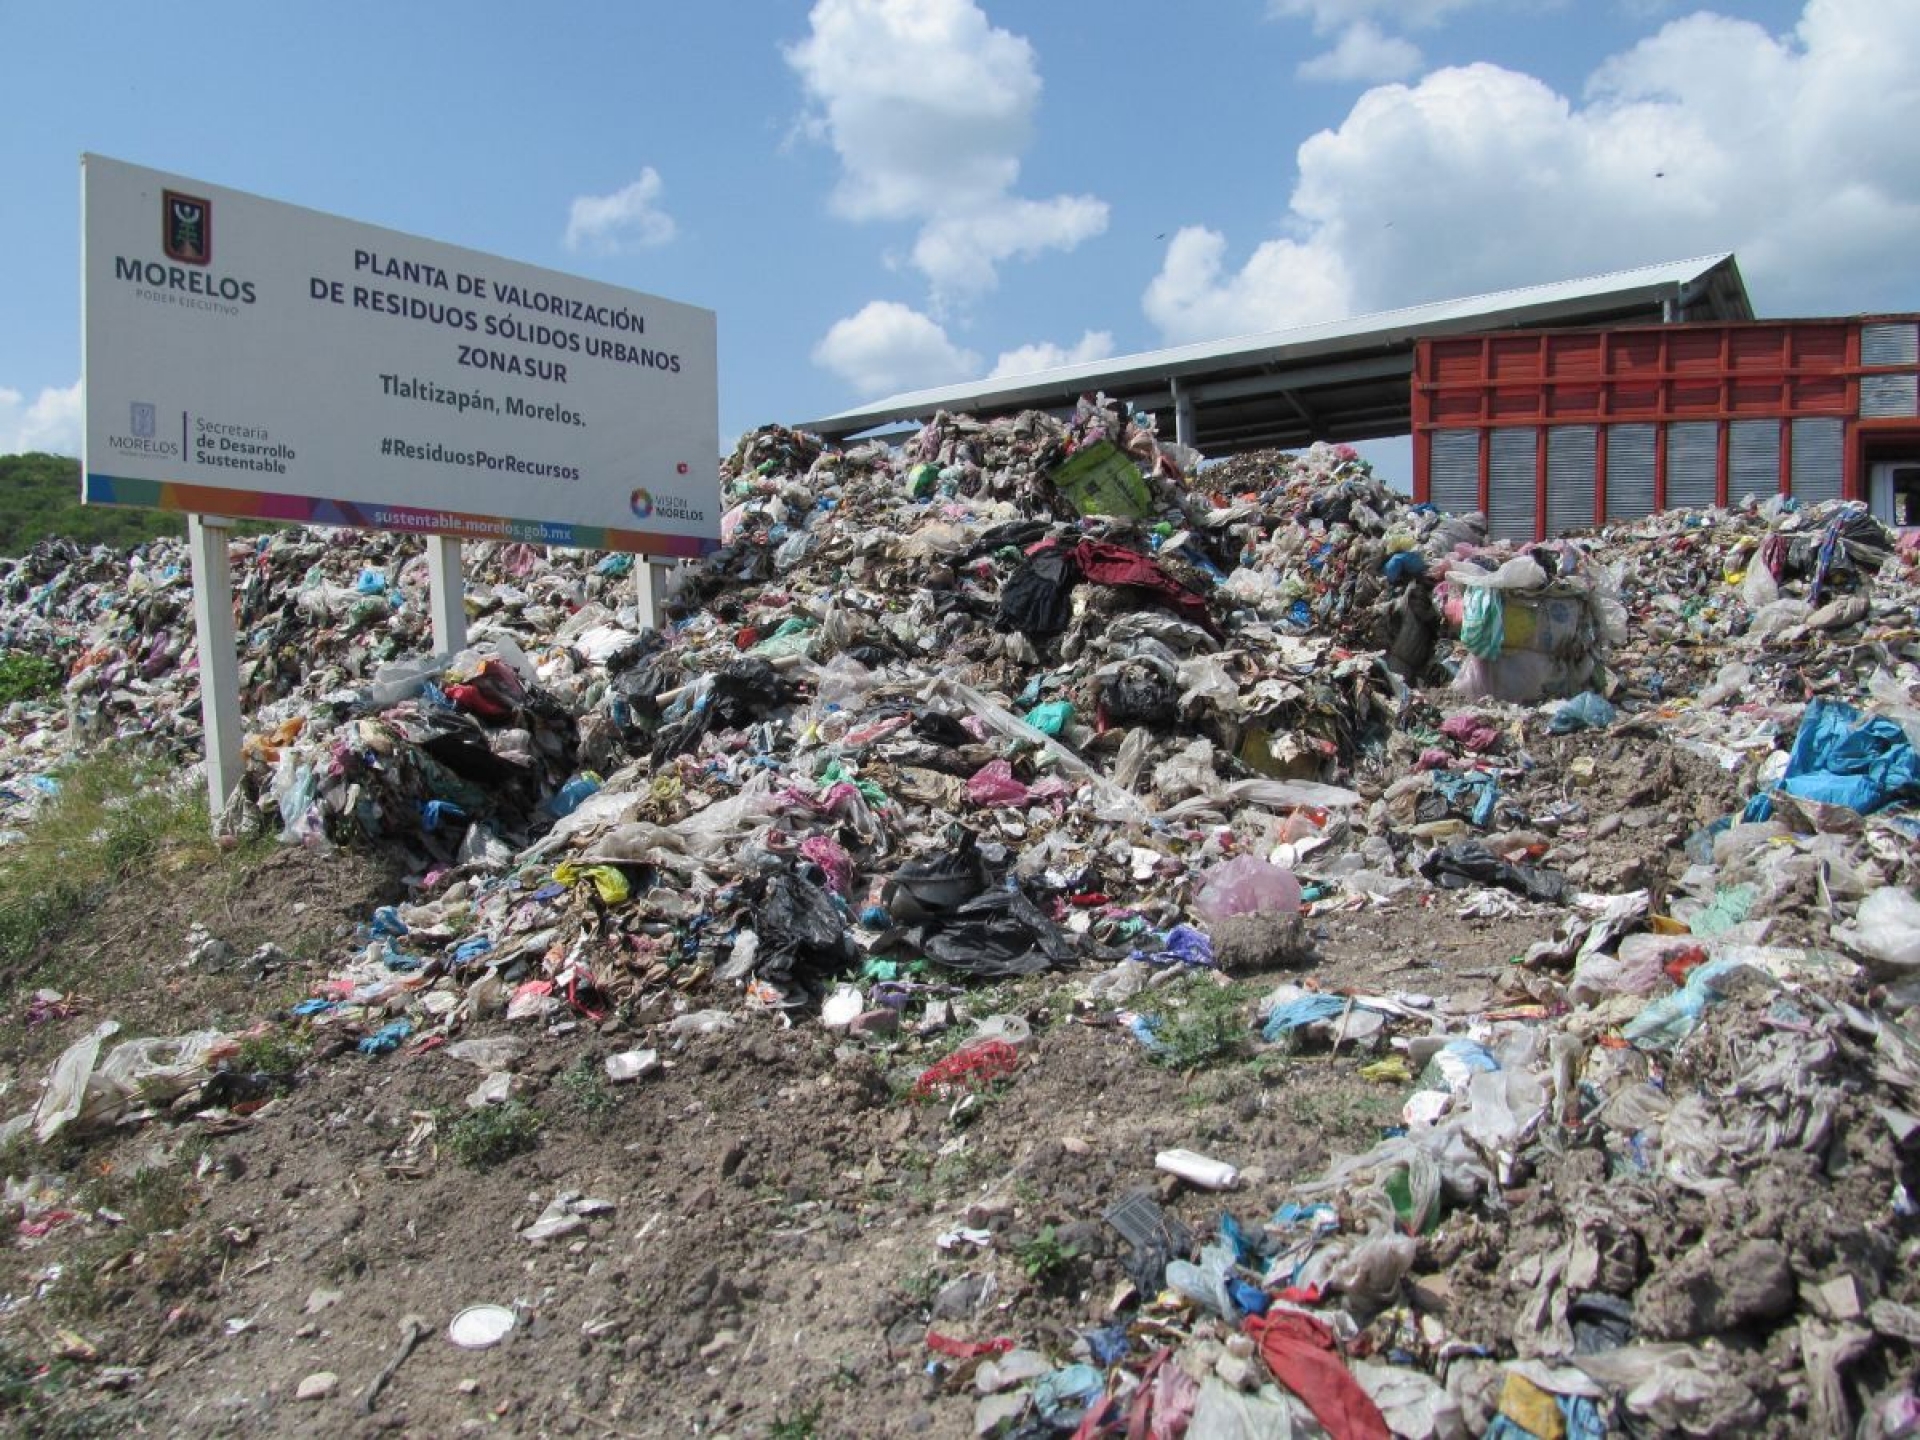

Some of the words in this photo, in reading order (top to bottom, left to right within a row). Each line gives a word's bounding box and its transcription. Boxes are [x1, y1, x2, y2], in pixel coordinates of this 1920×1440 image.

[115, 256, 257, 304] MORELOS
[354, 249, 449, 290] PLANTA
[457, 273, 487, 299] DE
[492, 280, 645, 334] VALORIZACIÓN
[135, 288, 175, 304] PODER
[310, 277, 345, 304] DE
[353, 285, 478, 331] RESIDUOS
[485, 313, 580, 352] SÓLIDOS
[585, 336, 681, 373] URBANOS
[379, 373, 500, 415] Tlaltizapán,
[505, 396, 586, 428] Morelos.
[109, 435, 178, 456] MORELOS
[196, 433, 216, 449] de
[219, 437, 296, 460] Desarrollo
[381, 437, 580, 481] #ResiduosPorRecursos
[196, 450, 287, 475] Sustentable
[373, 511, 572, 540] sustentable.morelos.gob.mx
[655, 507, 704, 521] MORELOS
